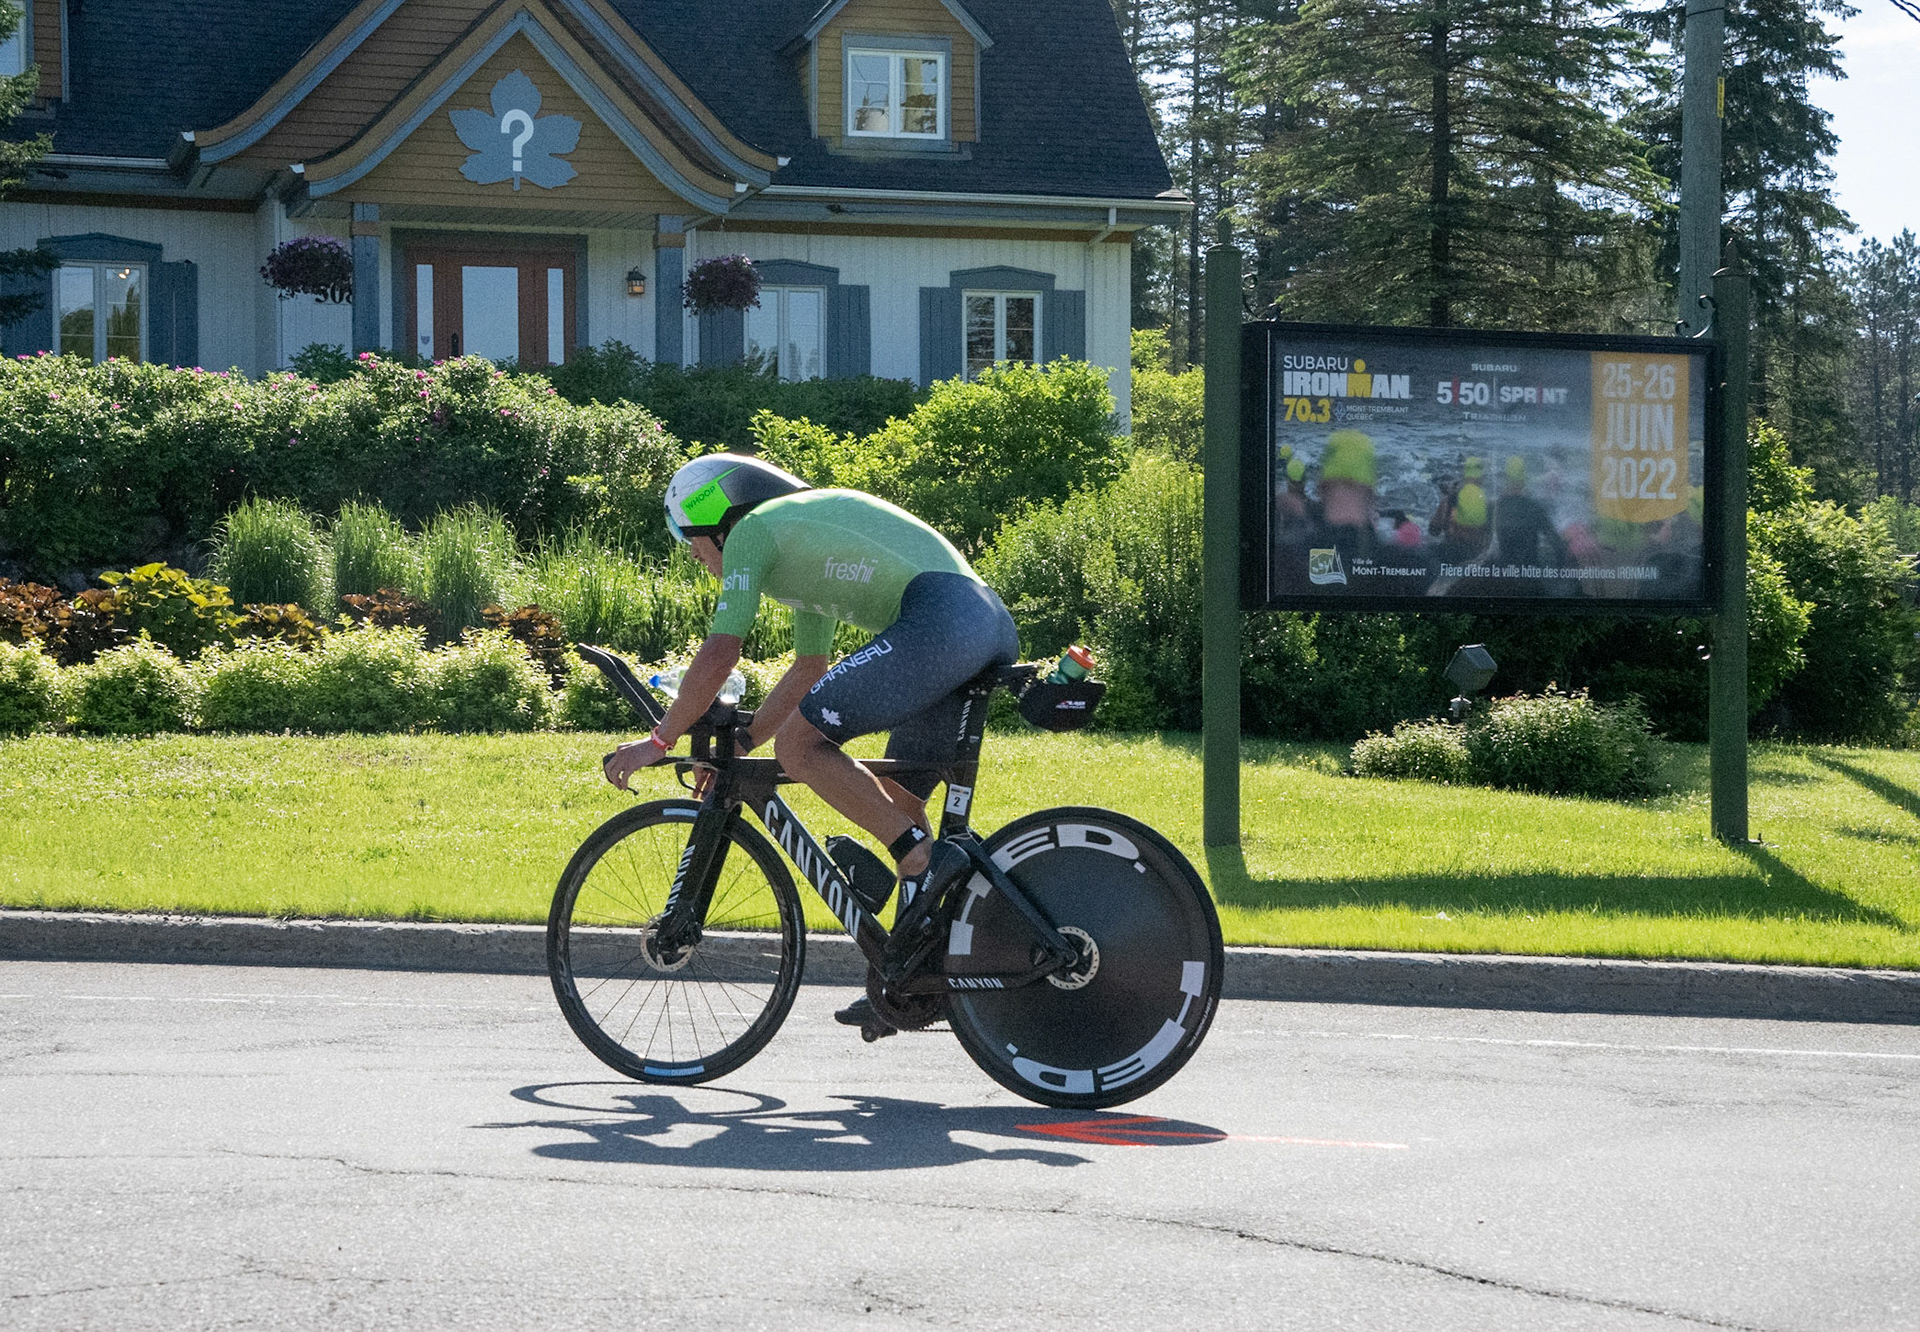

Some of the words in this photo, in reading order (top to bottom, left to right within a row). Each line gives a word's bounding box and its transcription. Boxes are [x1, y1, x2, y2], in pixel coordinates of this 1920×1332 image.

[1283, 355, 1348, 371] SUBARU
[1283, 358, 1410, 399] IRONMAN
[1471, 363, 1518, 372] SUBARU
[1602, 362, 1676, 400] 25-26
[1283, 397, 1331, 423] 70.3
[1601, 402, 1675, 452] JUIN
[1601, 456, 1677, 500] 2022
[685, 485, 716, 510] WHOOP
[824, 556, 879, 584] freshii
[1440, 563, 1463, 577] Fière
[1464, 563, 1490, 578] d'être
[1491, 564, 1500, 577] la
[1502, 565, 1520, 578] ville
[1521, 565, 1541, 579] hôte
[1542, 565, 1559, 579] des
[1560, 566, 1616, 581] compétitions
[1617, 566, 1657, 580] IRONMAN
[810, 639, 893, 694] GARNEAU
[957, 699, 973, 742] CANYON
[953, 796, 961, 807] 2
[661, 844, 697, 918] CANYON
[764, 800, 862, 940] CANYON
[948, 977, 1004, 988] CANYON
